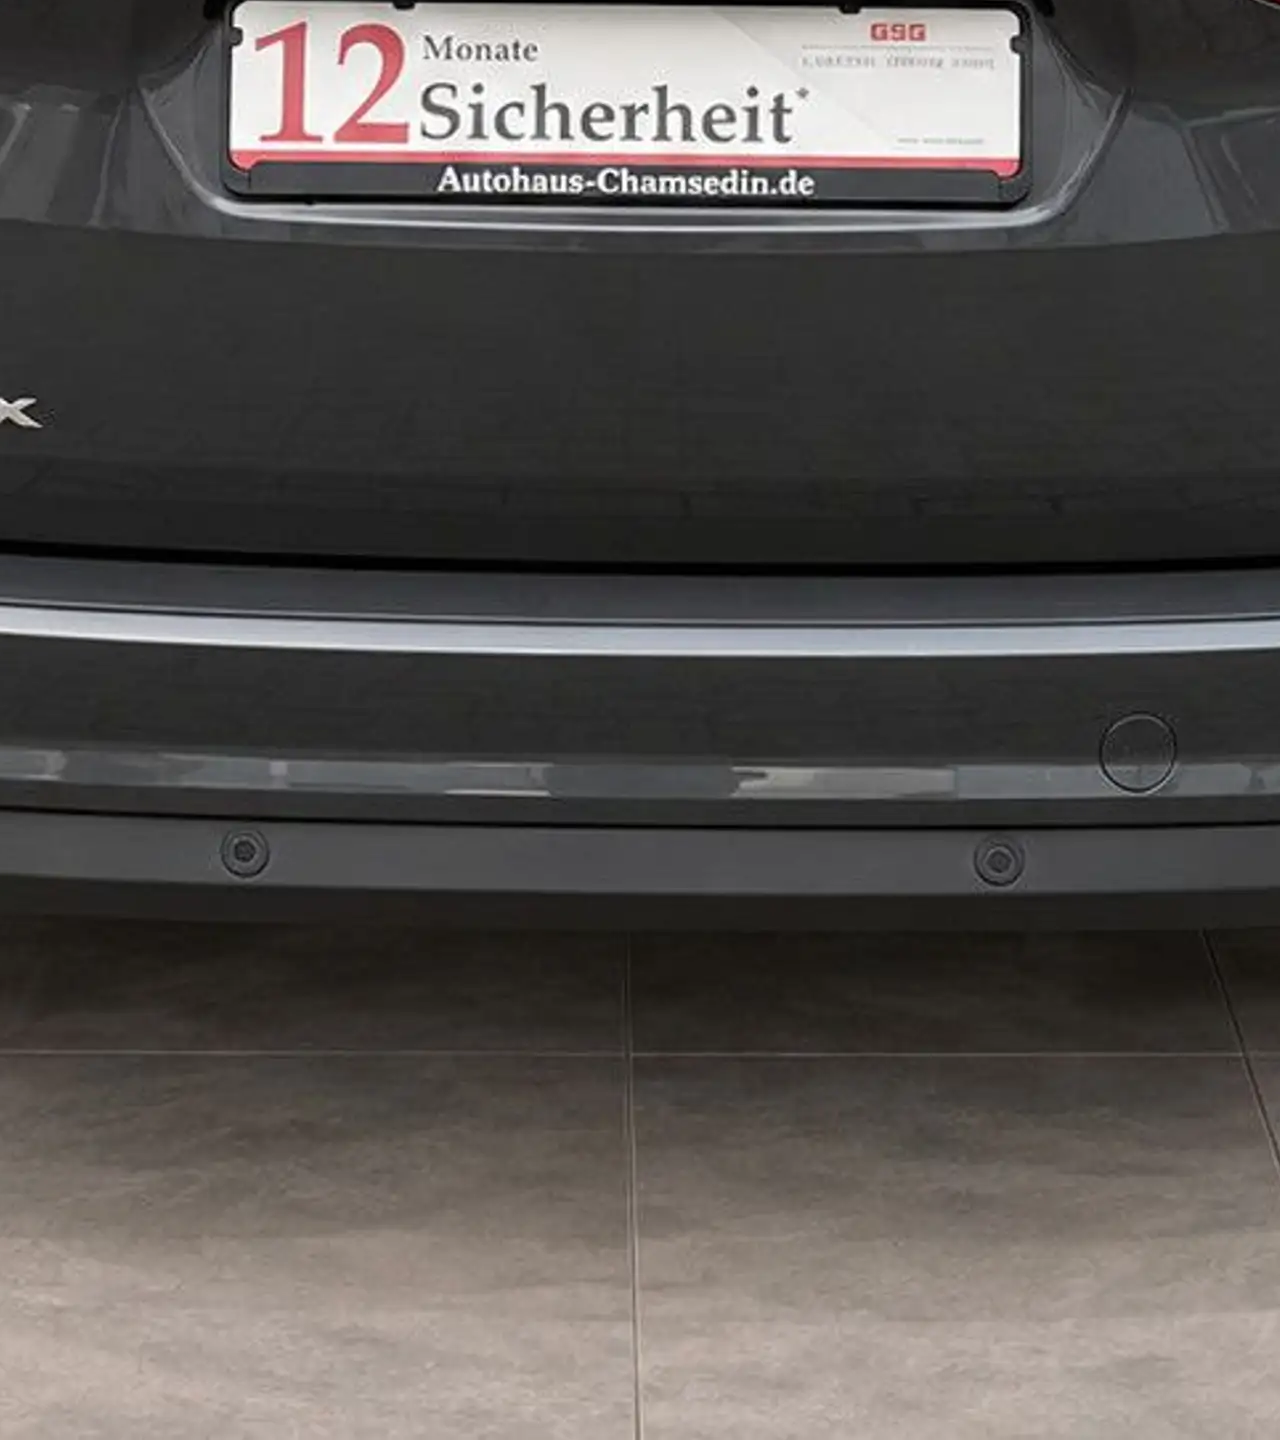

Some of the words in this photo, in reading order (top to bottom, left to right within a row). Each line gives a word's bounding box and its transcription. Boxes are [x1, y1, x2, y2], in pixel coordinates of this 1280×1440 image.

[870, 23, 926, 42] GSG
[255, 21, 410, 144] 12
[422, 35, 538, 63] Monate
[437, 166, 816, 197] Autohaus-Chamsedin.de
